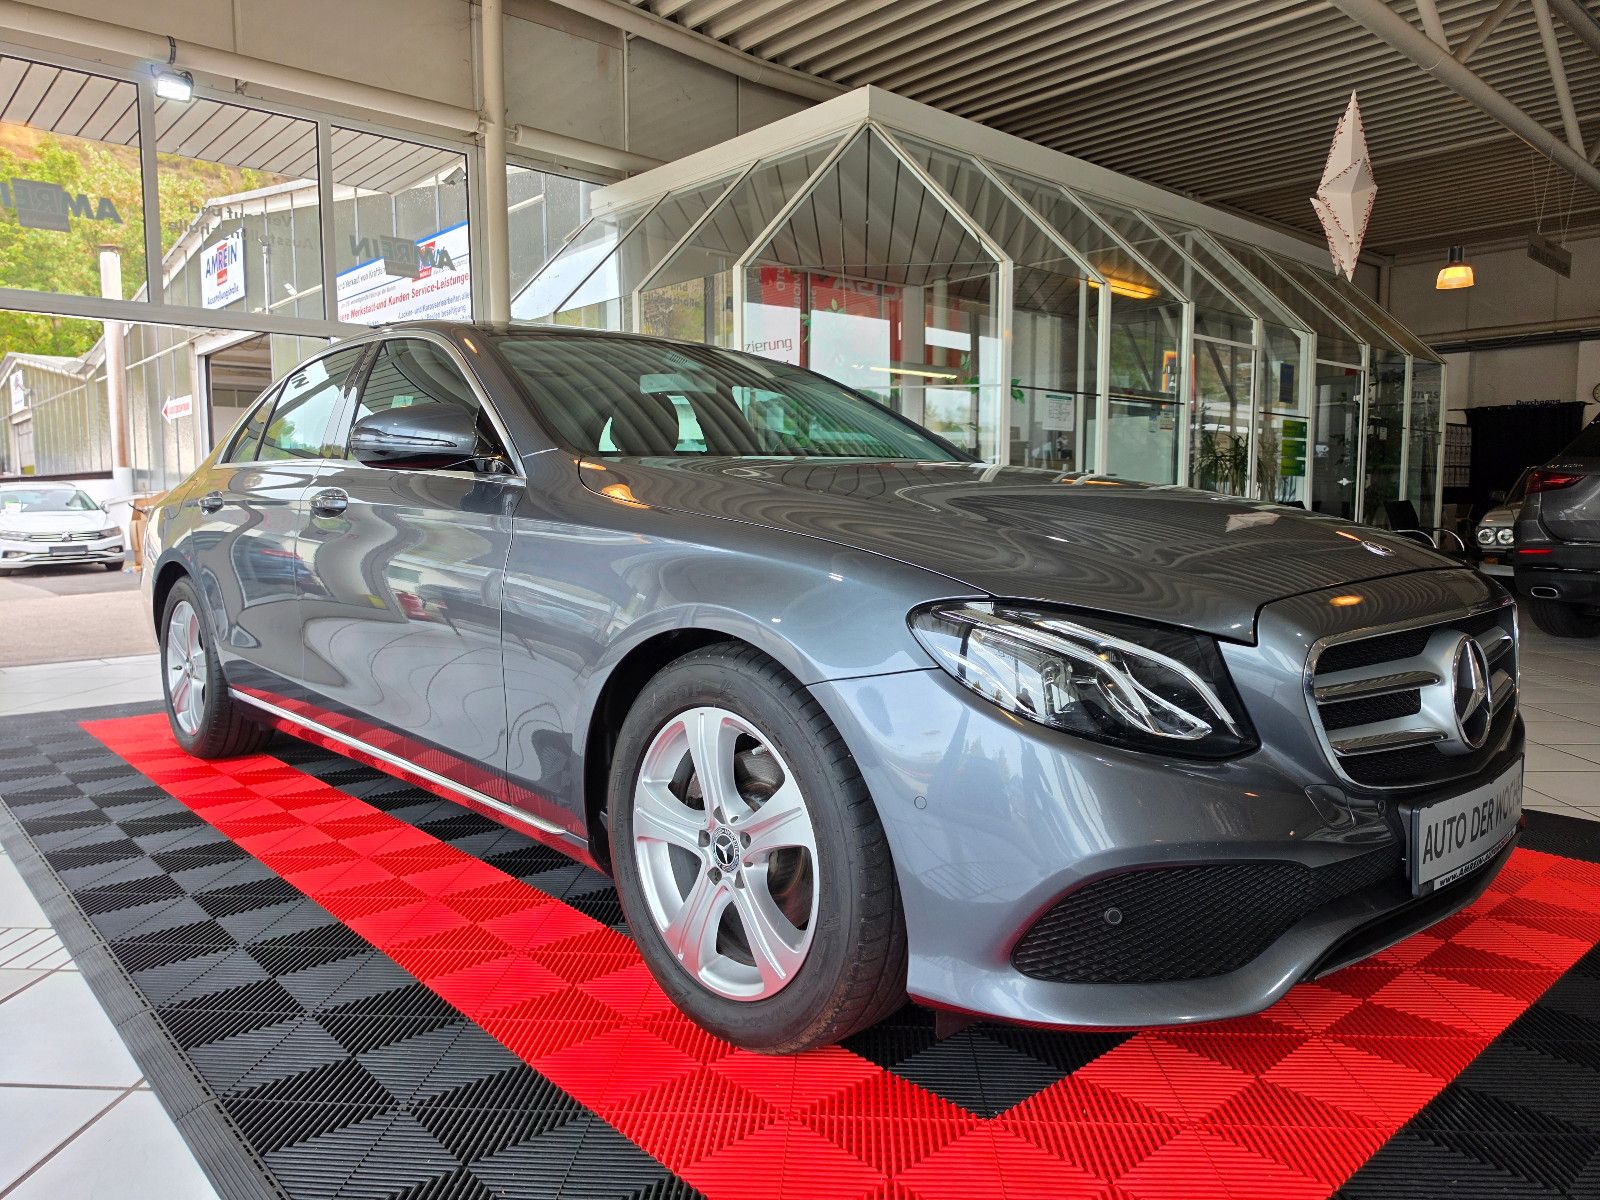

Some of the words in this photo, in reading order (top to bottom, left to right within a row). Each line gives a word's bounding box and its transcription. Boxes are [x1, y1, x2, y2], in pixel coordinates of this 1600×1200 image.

[205, 242, 238, 278] AMREIN
[388, 291, 410, 306] Kunden
[1423, 812, 1466, 864] AUTO
[1470, 798, 1495, 842] DER
